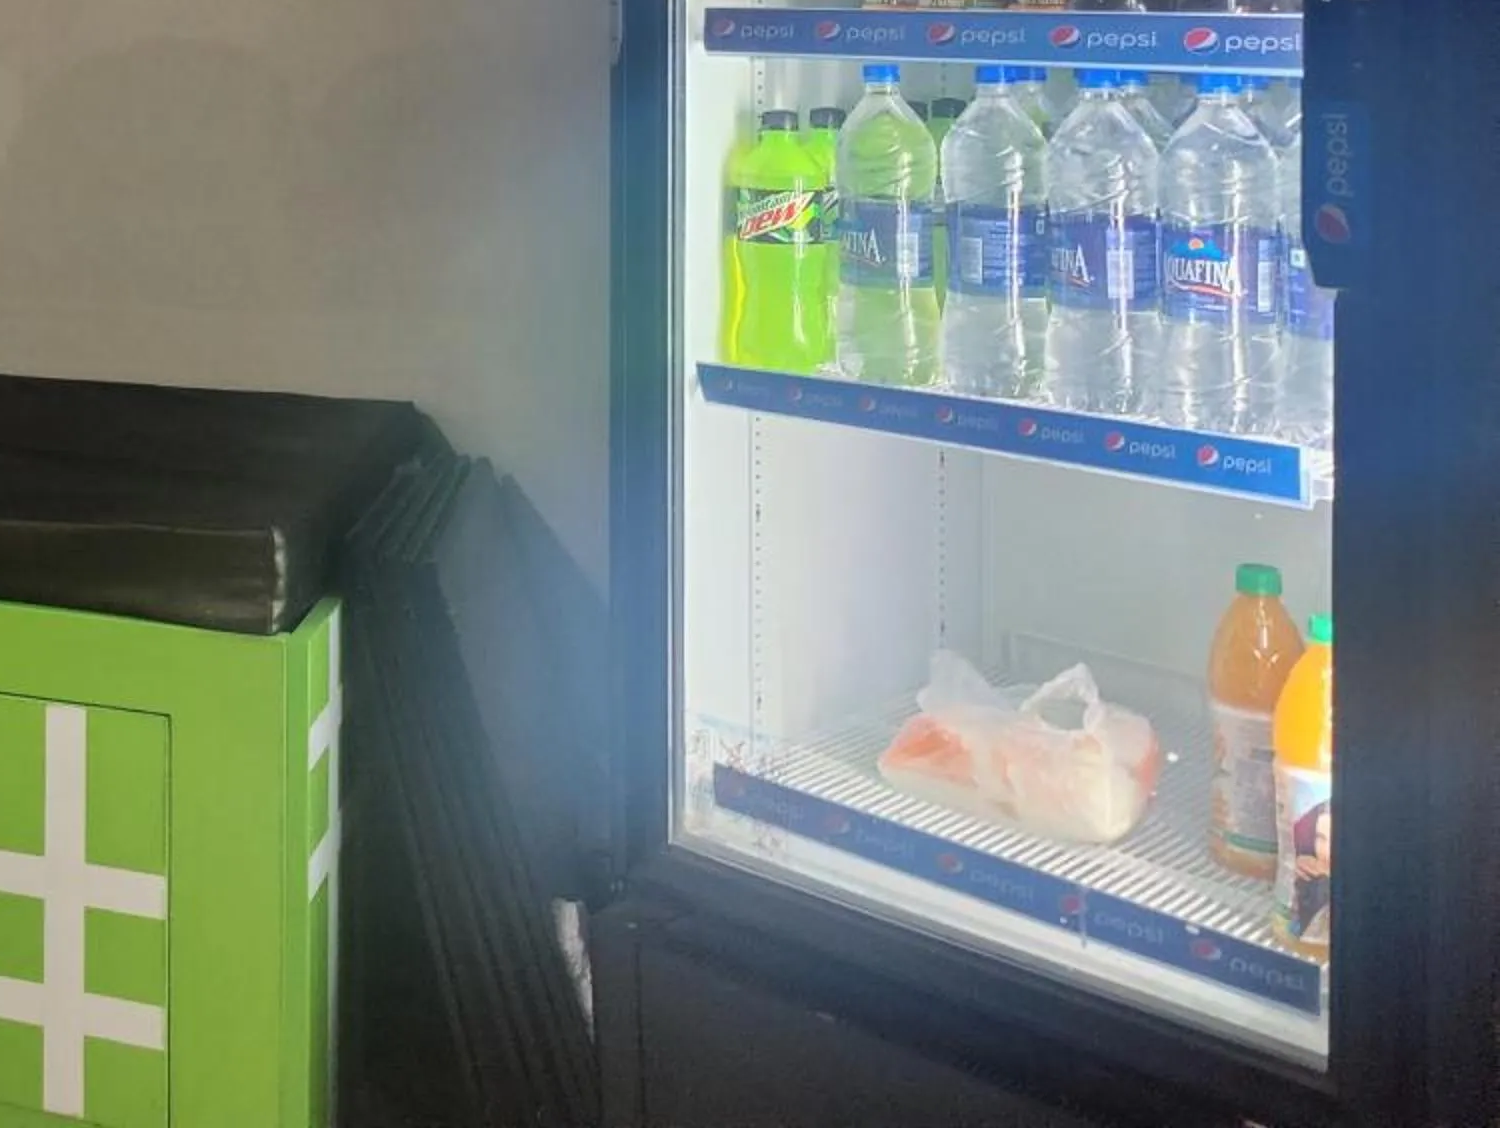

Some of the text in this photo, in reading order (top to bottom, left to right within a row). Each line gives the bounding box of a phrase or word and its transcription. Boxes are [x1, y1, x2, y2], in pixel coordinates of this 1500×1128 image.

[740, 23, 1301, 55] pepsi pepsi pepsi pepsi pepsi
[1322, 112, 1354, 198] pepsi
[1041, 426, 1084, 445] pepsi
[1129, 440, 1176, 460] pepsi
[1222, 455, 1272, 475] pepsi
